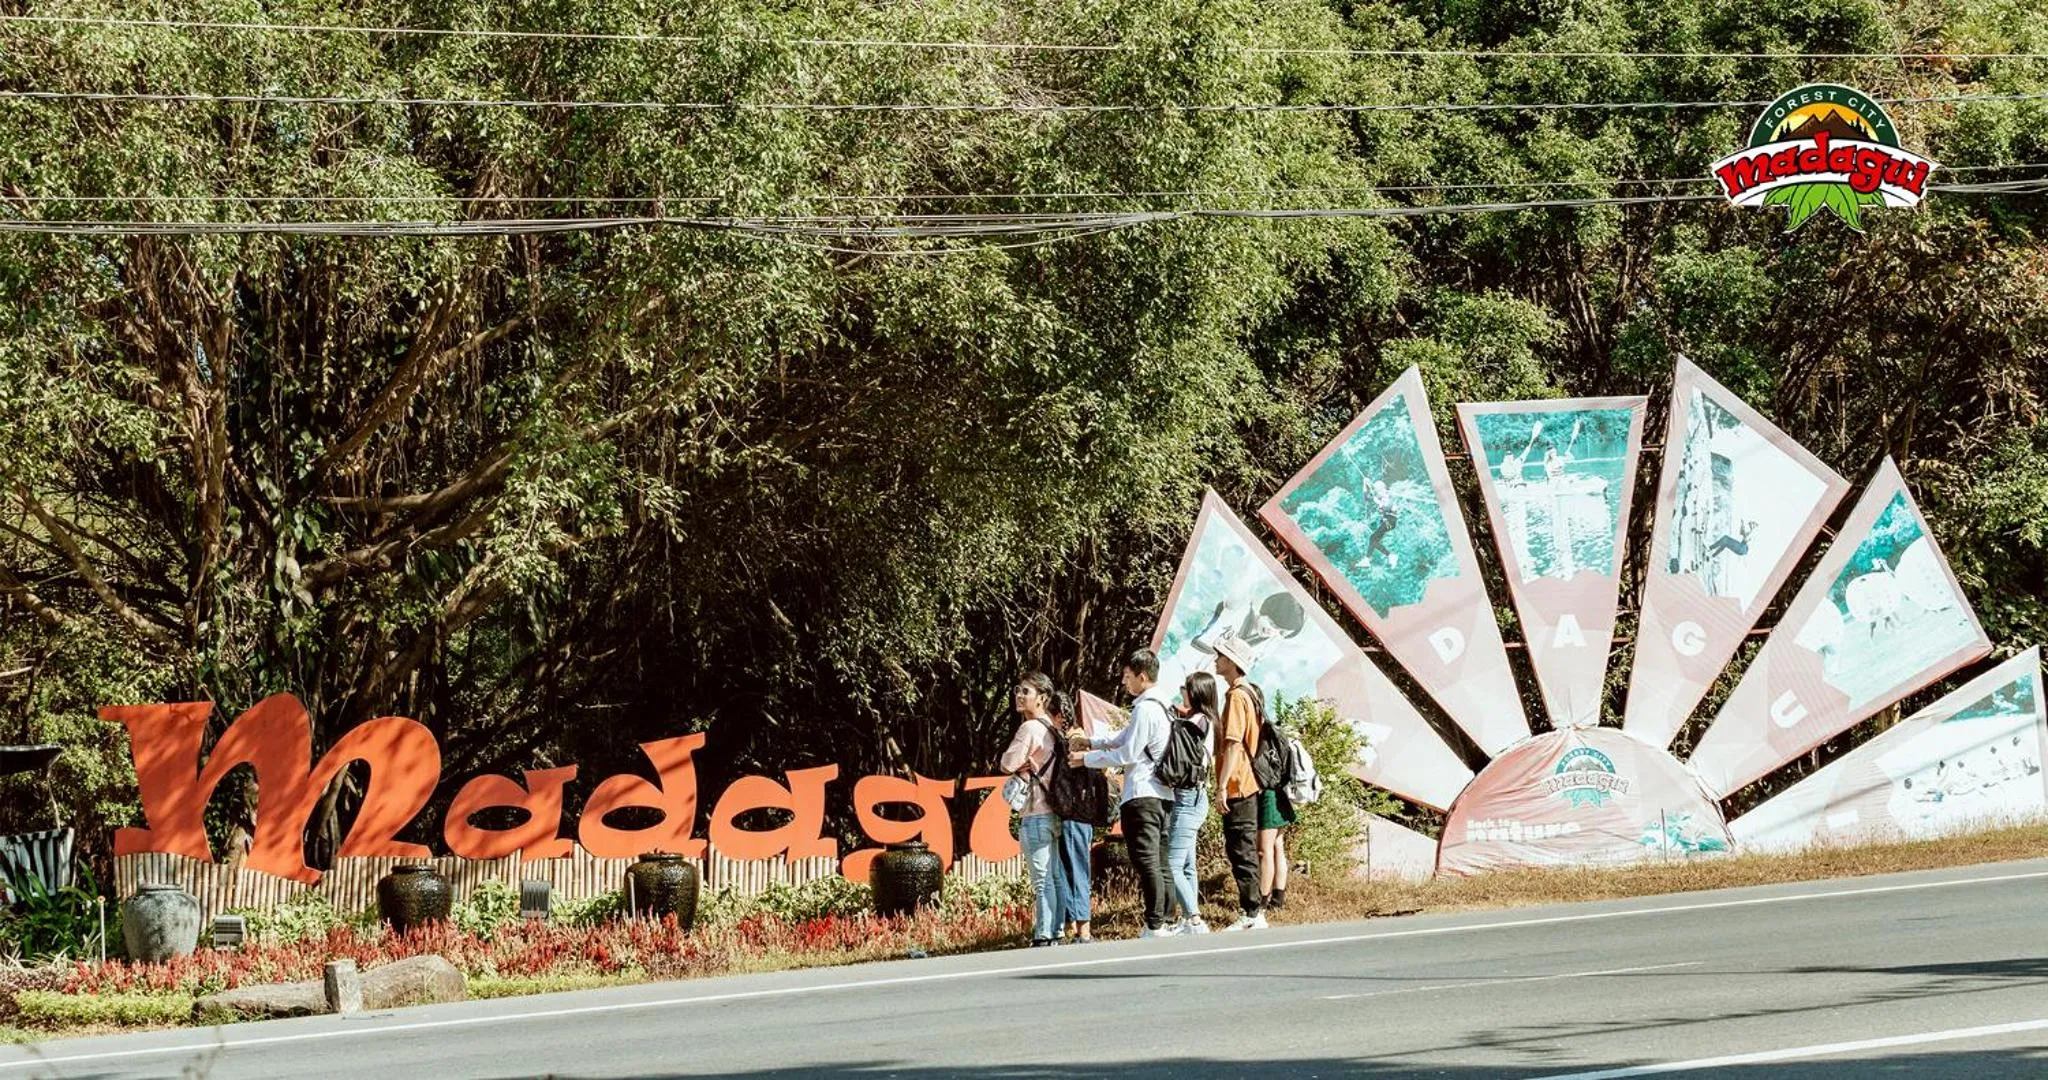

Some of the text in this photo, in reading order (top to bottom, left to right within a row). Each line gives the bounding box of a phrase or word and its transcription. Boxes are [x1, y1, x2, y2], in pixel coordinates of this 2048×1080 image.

[1427, 626, 1466, 665] D
[1552, 614, 1588, 649] A
[1671, 620, 1708, 657] G
[1770, 689, 1809, 728] U
